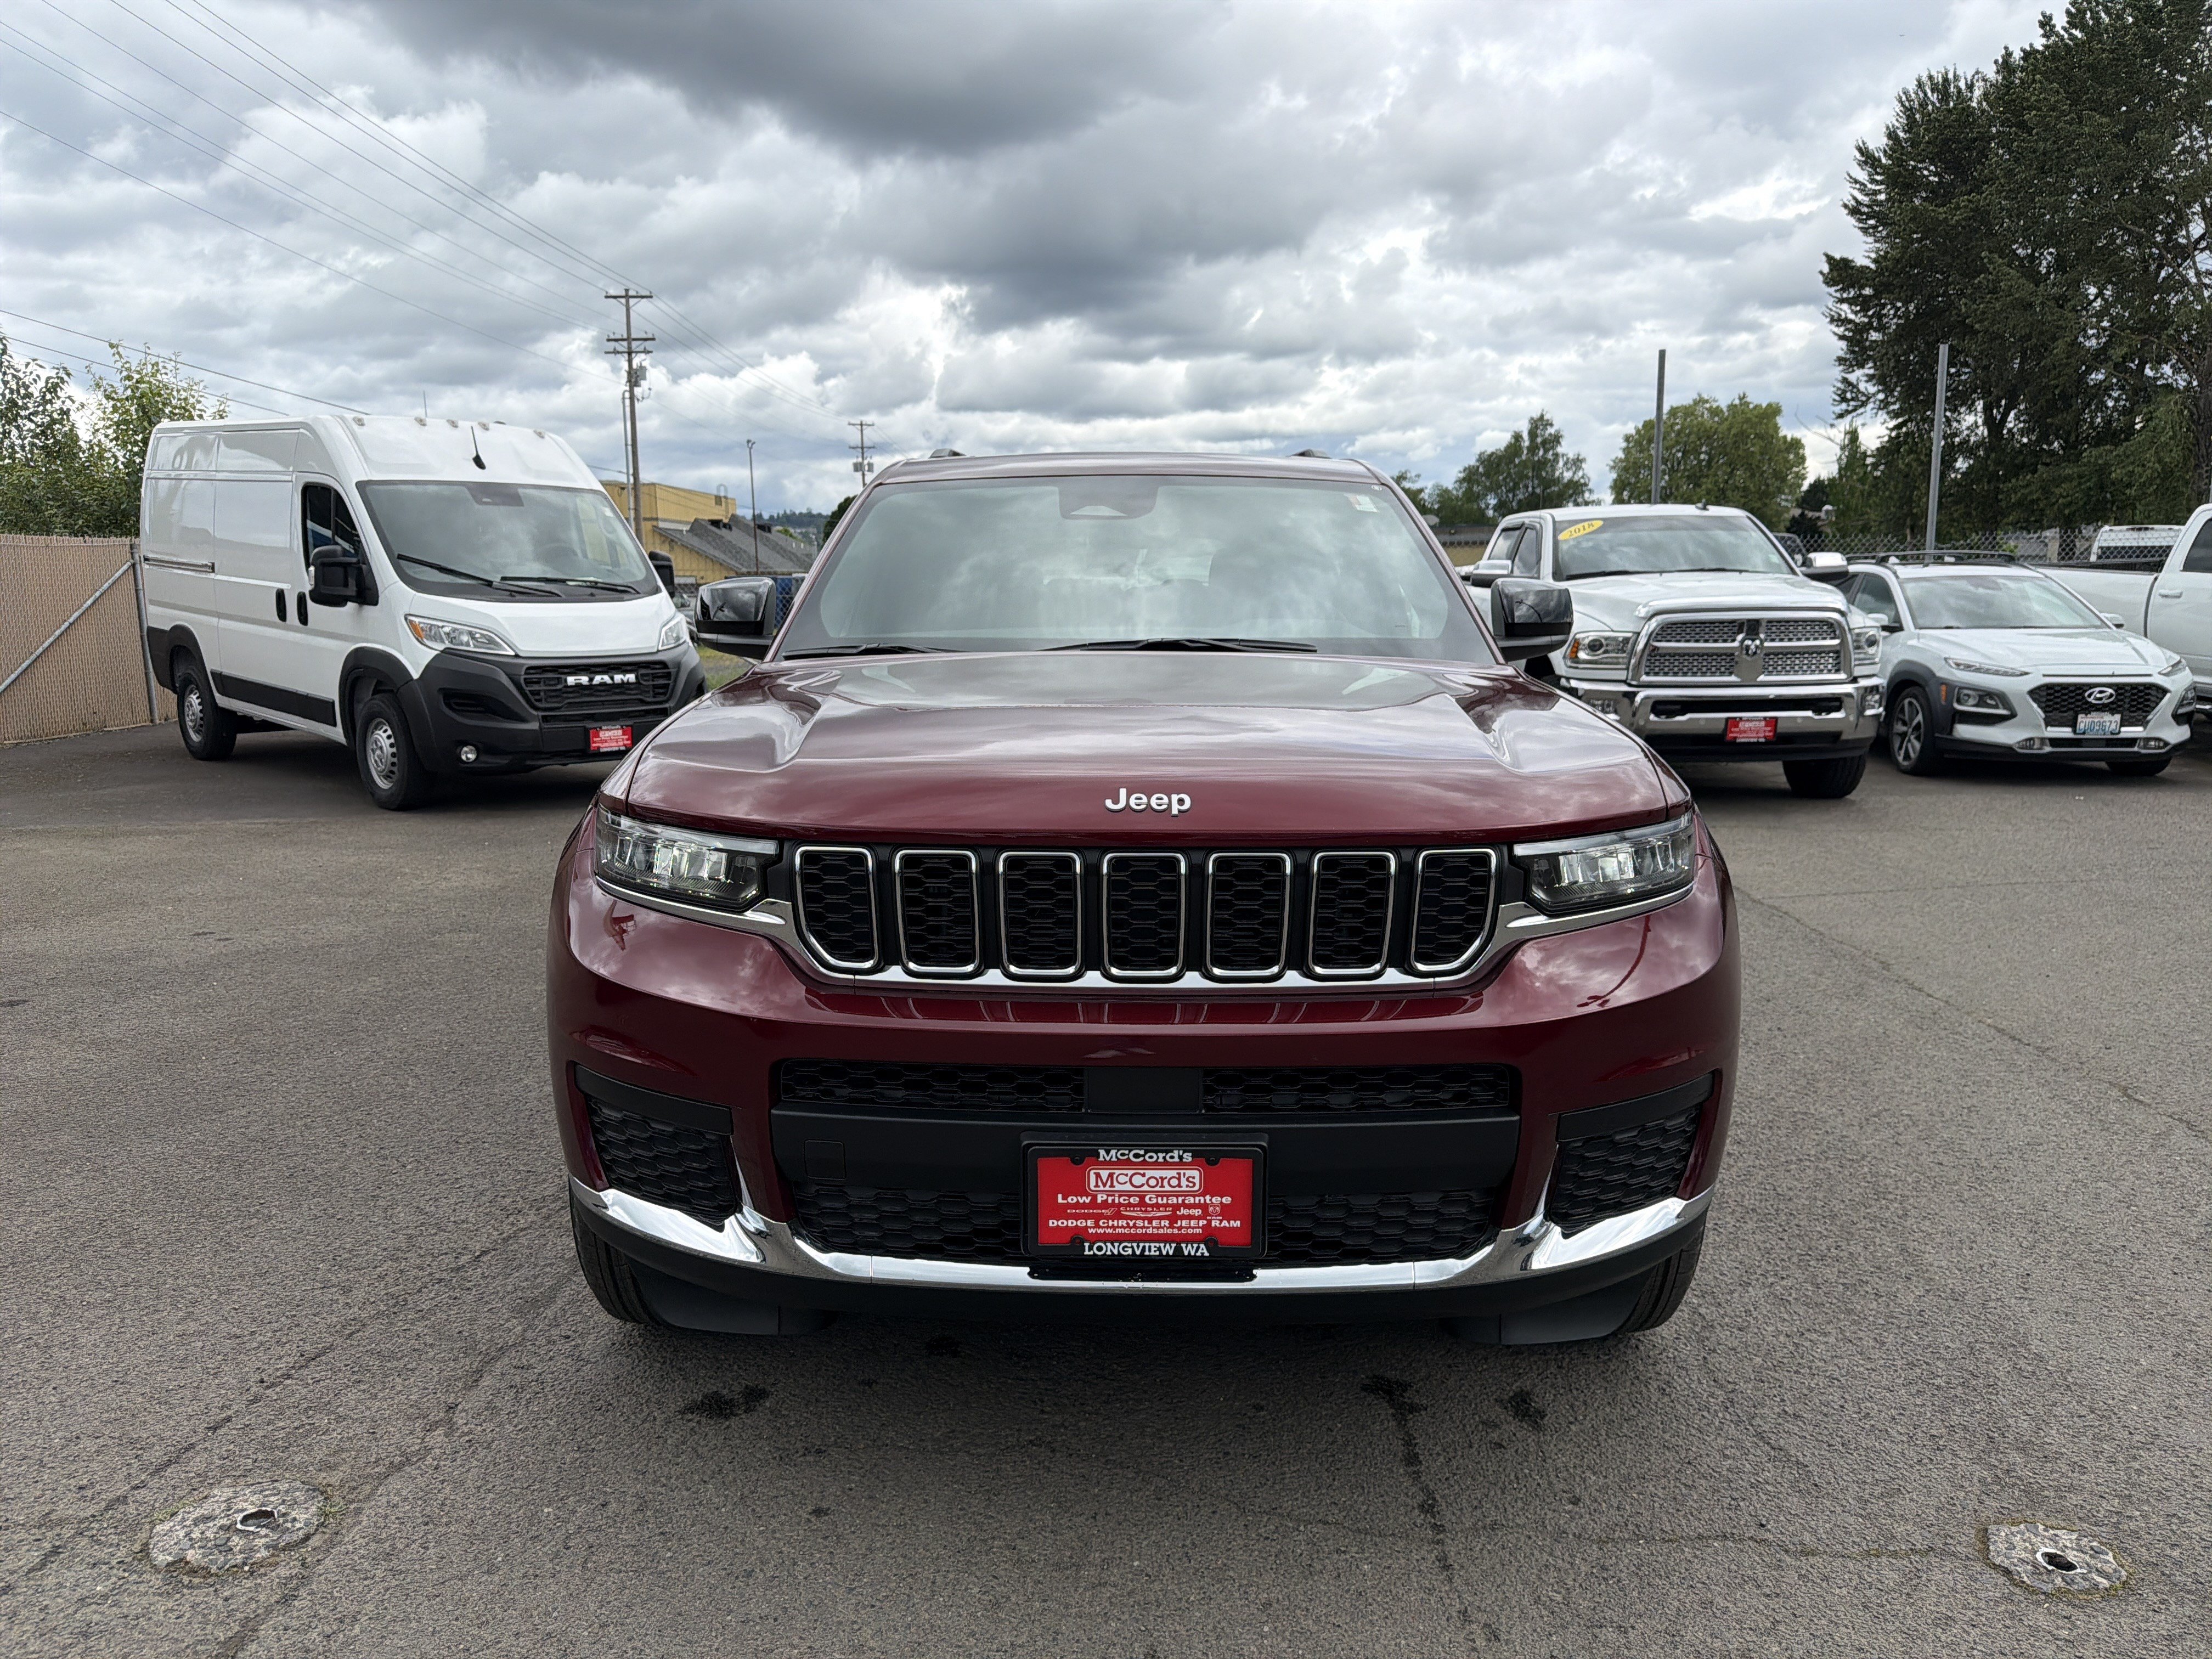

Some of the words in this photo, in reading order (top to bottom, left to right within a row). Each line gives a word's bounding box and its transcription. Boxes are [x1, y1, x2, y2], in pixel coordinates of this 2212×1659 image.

[567, 673, 636, 686] RAM
[1105, 788, 1192, 817] Jeep
[1098, 1149, 1193, 1163] McCord's
[1093, 1171, 1197, 1189] McCord's
[1058, 1193, 1092, 1204] Low
[1097, 1194, 1139, 1204] Price
[1144, 1194, 1232, 1204] Guarantee
[1176, 1206, 1202, 1216] Jeep
[1048, 1219, 1096, 1227] DODGE
[1099, 1219, 1170, 1227] CHRYSLER
[1211, 1220, 1241, 1228] RAM
[1084, 1242, 1177, 1256] LONGVIEW
[1180, 1243, 1210, 1256] WA
